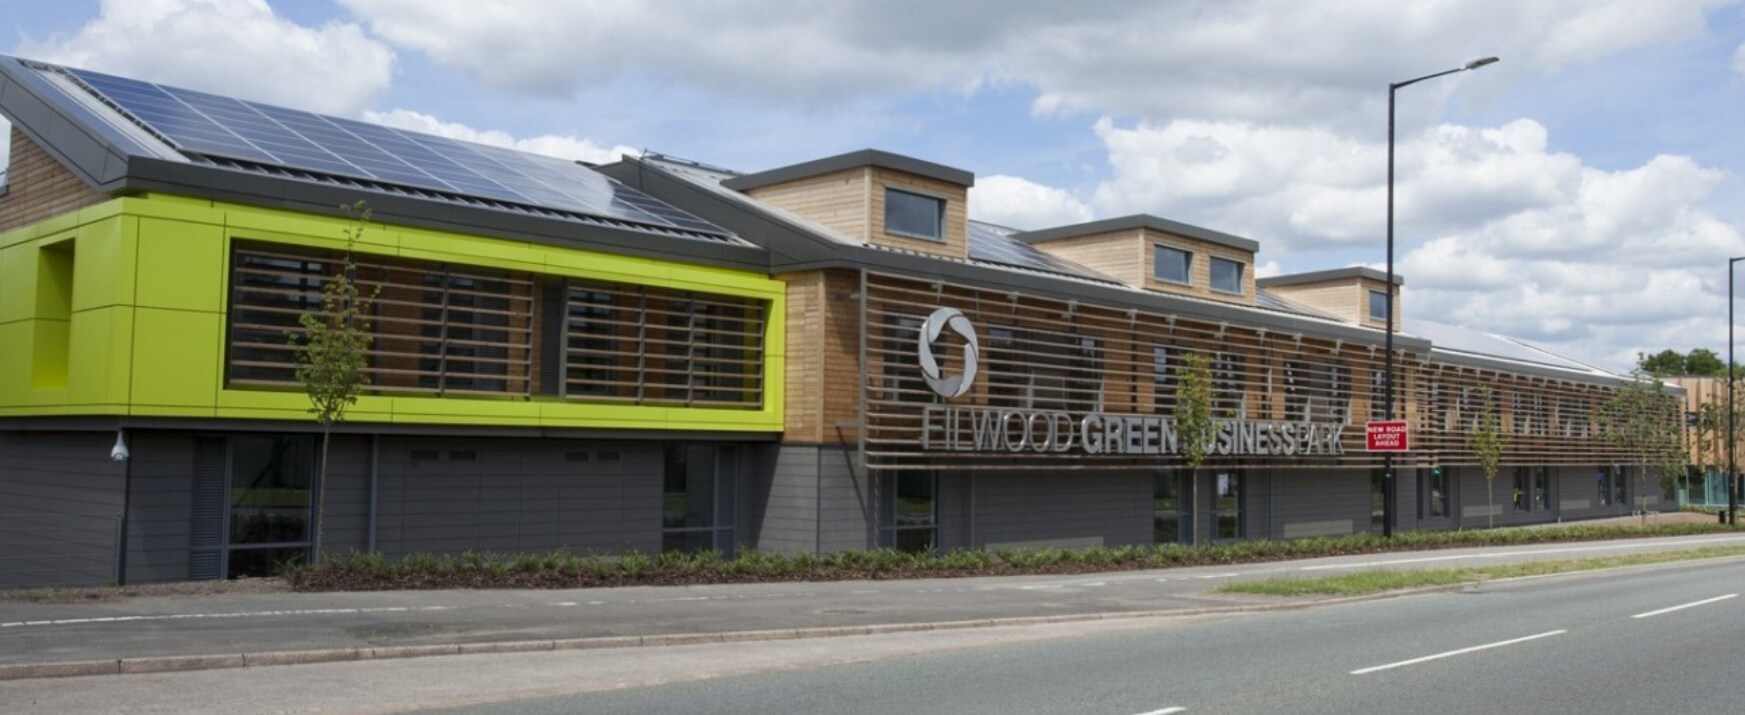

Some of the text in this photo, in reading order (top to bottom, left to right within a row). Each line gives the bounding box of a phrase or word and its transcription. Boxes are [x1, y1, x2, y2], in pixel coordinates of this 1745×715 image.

[922, 406, 1345, 456] FILWOOD GREEN USINESS PARK
